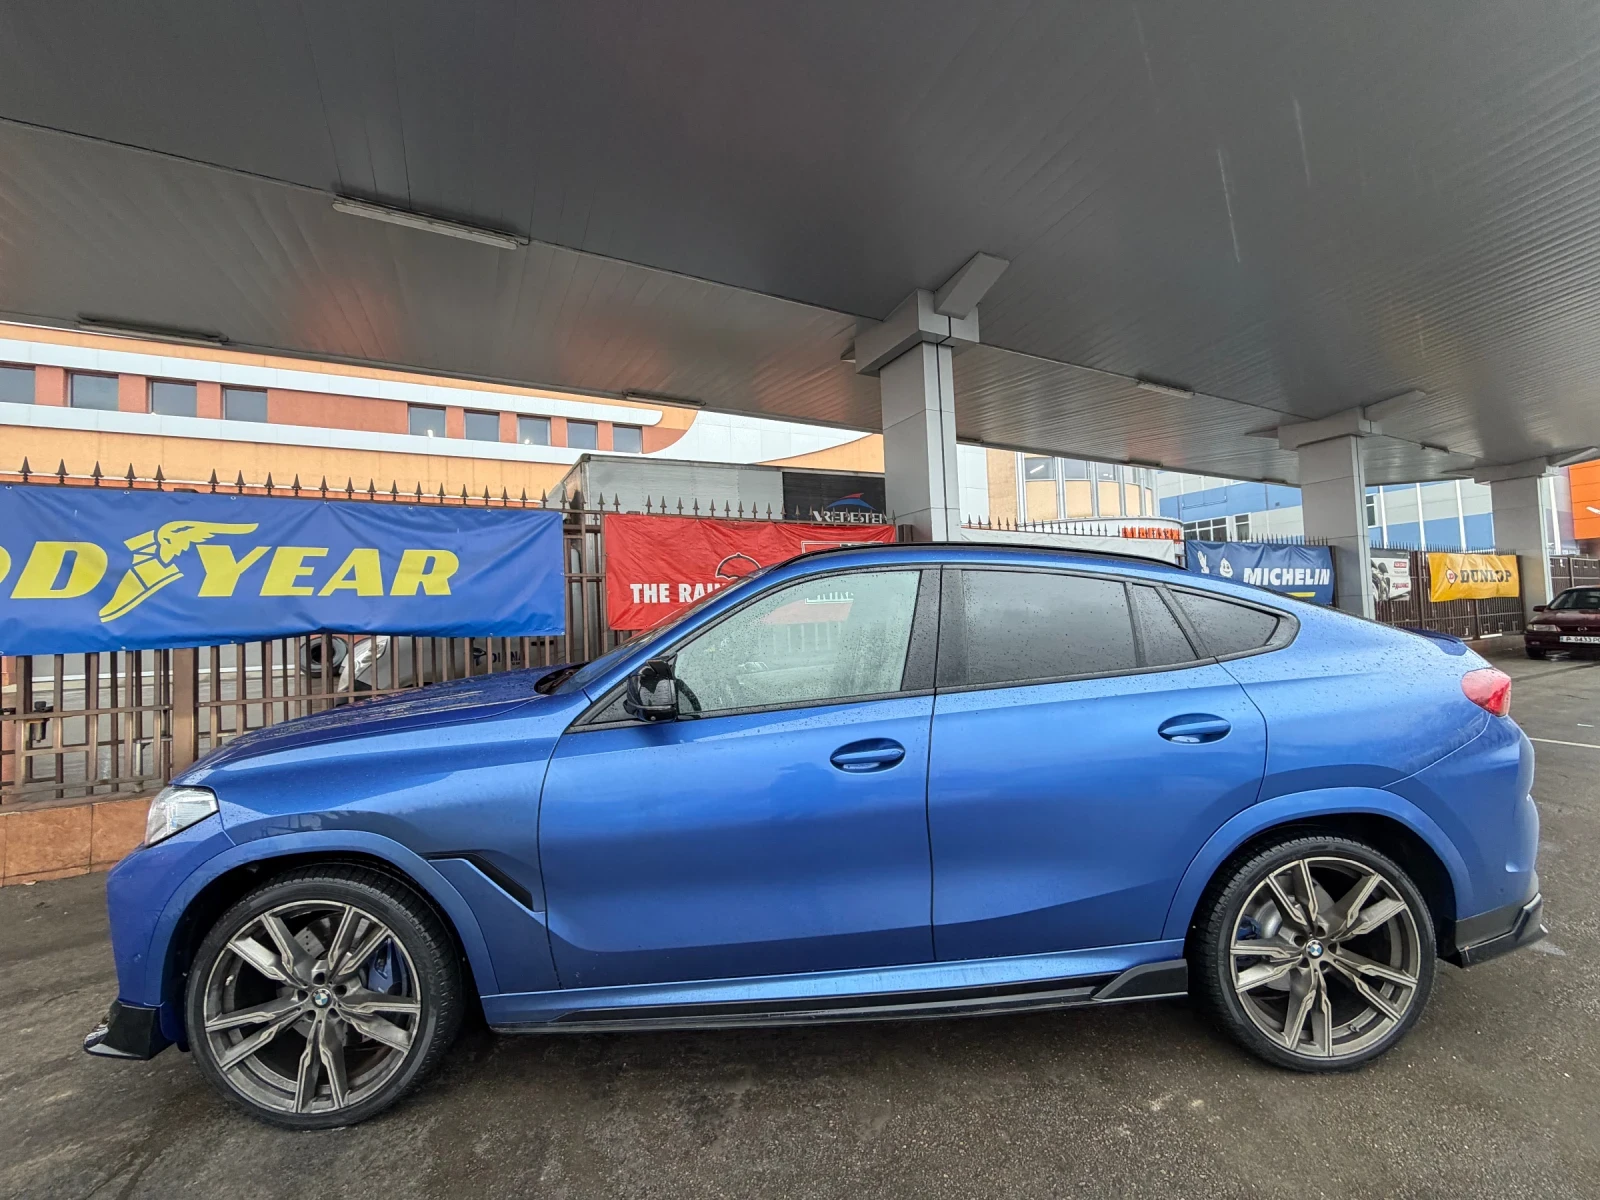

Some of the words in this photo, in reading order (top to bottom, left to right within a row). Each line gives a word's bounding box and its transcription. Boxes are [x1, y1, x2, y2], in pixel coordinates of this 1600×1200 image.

[1243, 567, 1330, 586] MICHELIN
[1460, 569, 1512, 583] DUNLOP
[630, 583, 670, 604] THE
[678, 583, 727, 604] RA
